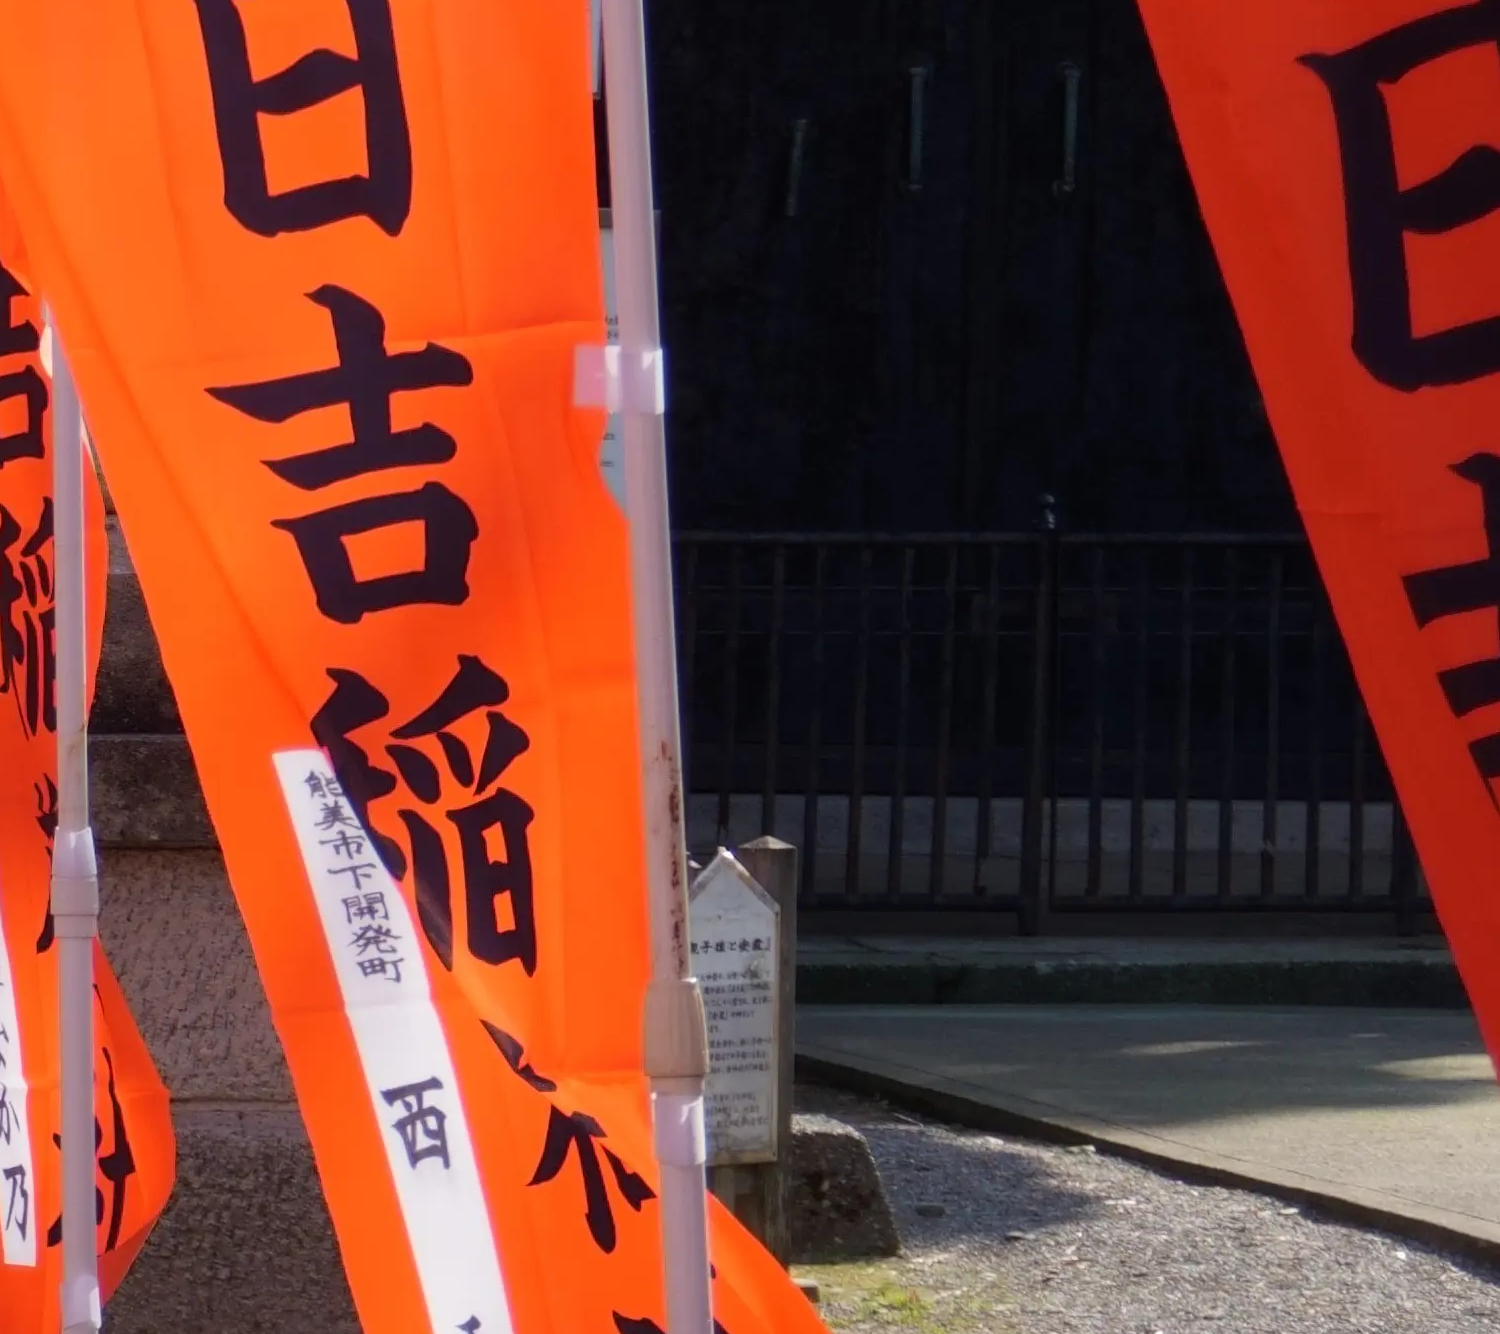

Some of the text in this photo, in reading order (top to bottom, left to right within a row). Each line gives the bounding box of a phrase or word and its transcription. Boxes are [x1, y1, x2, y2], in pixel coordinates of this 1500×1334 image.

[303, 769, 406, 984] 能美市下開発町
